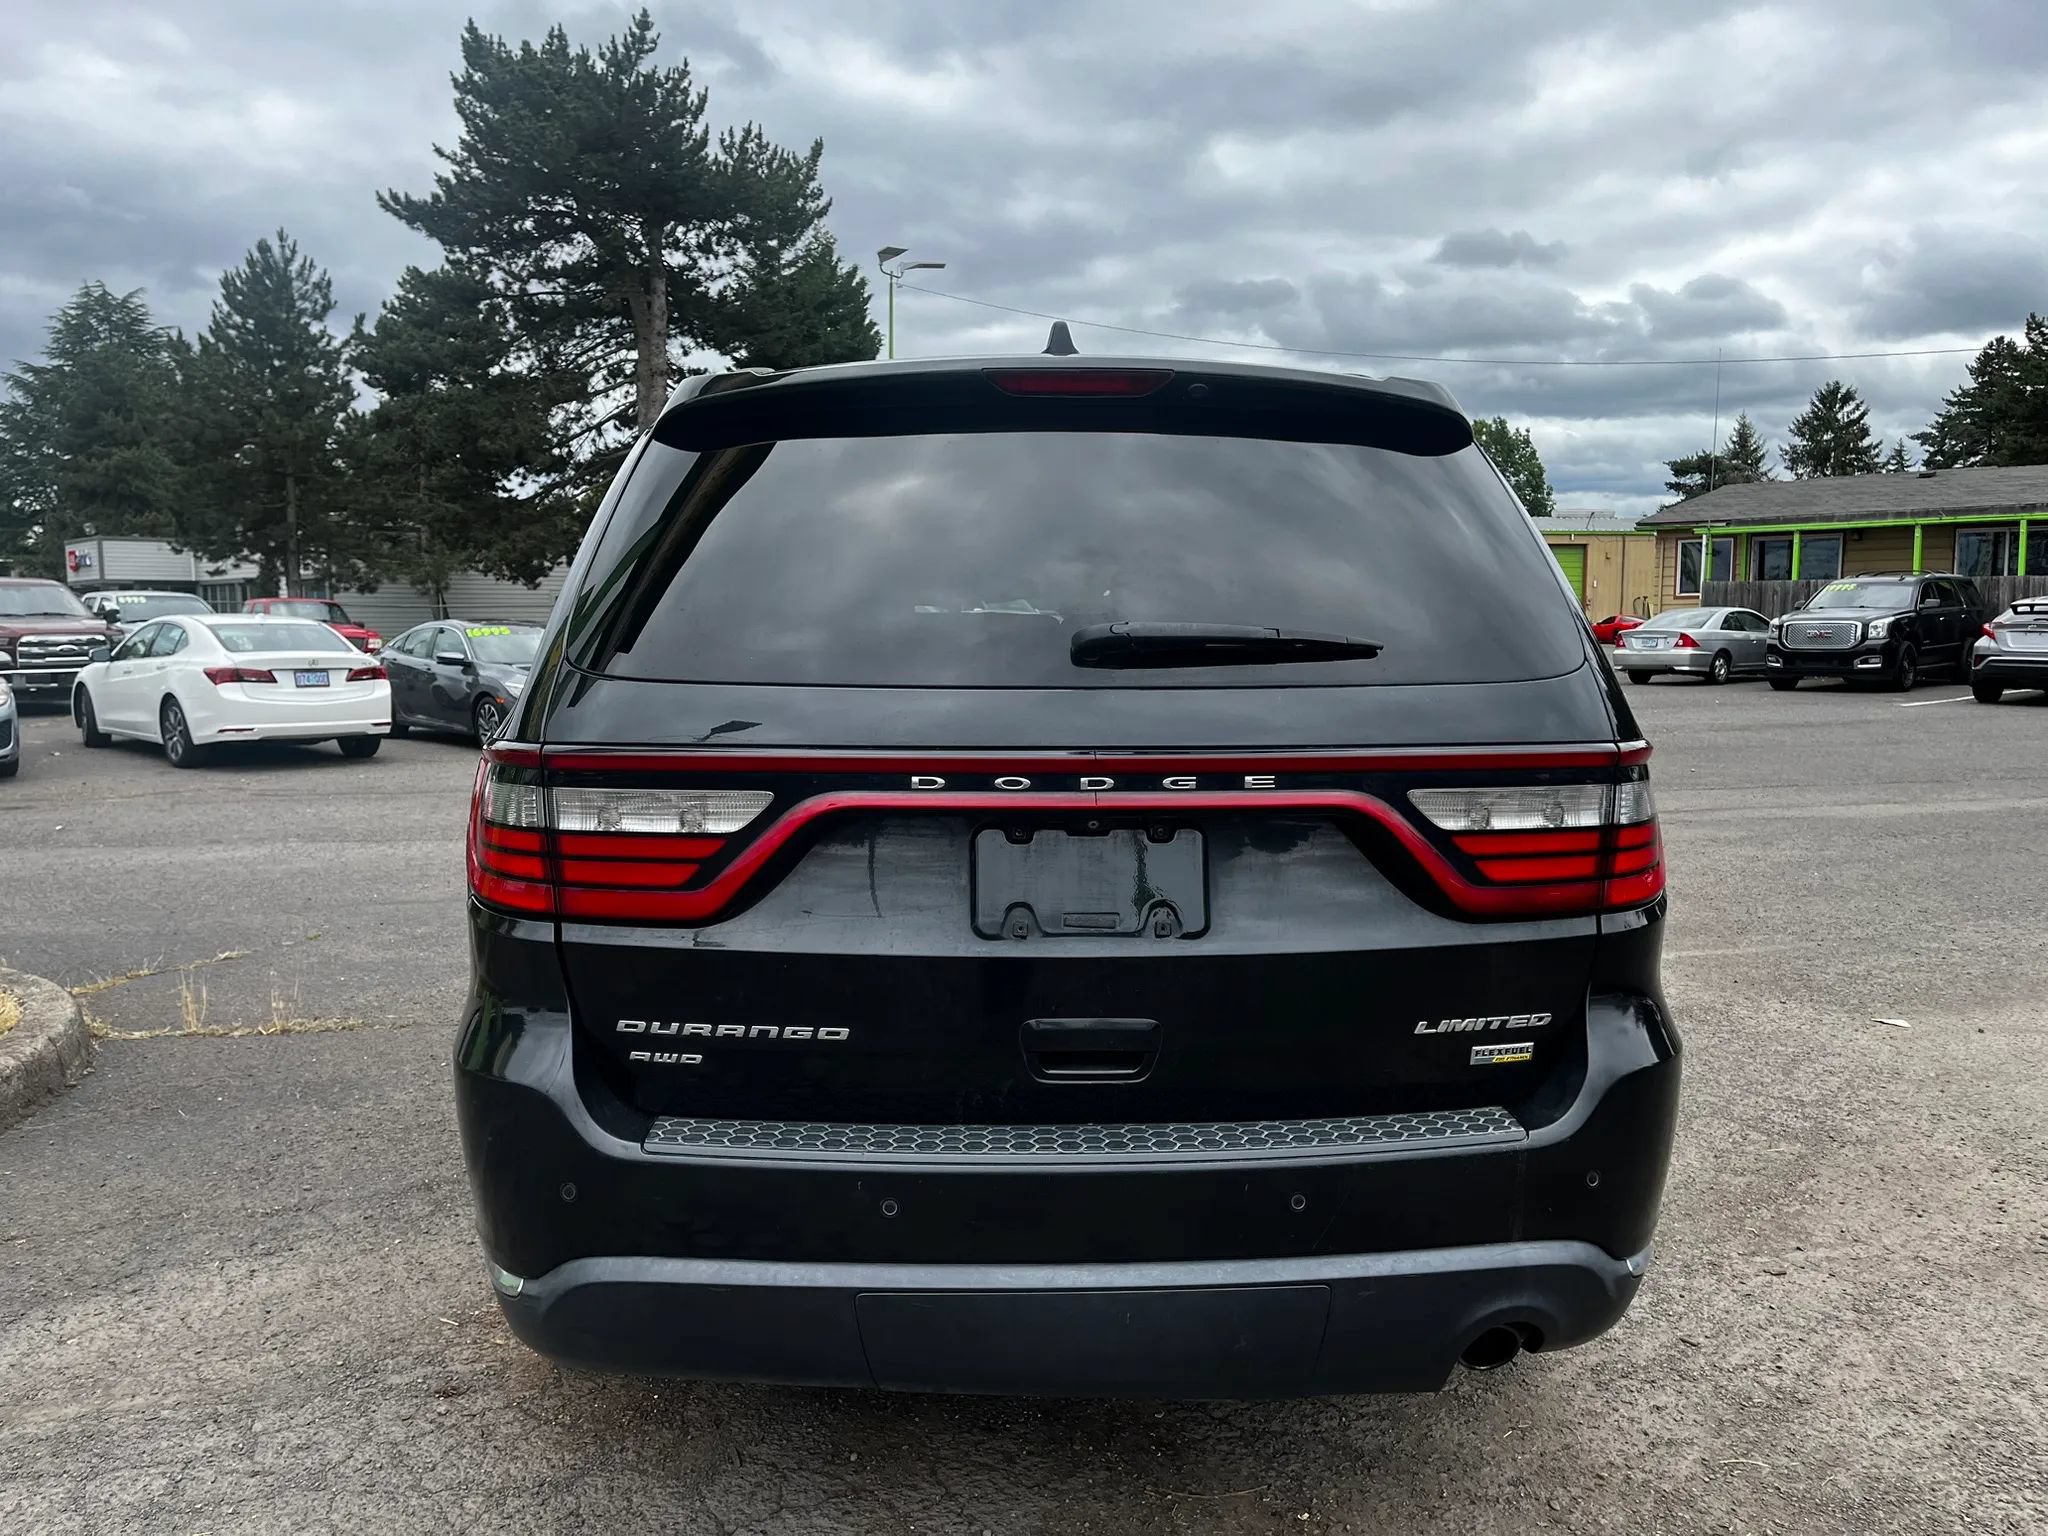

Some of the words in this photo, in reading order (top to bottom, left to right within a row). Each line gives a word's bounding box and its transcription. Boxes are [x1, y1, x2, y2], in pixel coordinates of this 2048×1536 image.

[911, 775, 1276, 790] DODGE
[615, 1019, 850, 1041] DURANGO
[1413, 1013, 1553, 1035] LIMITED
[629, 1051, 703, 1065] AWD
[1474, 1046, 1533, 1057] FLEXFUEL
